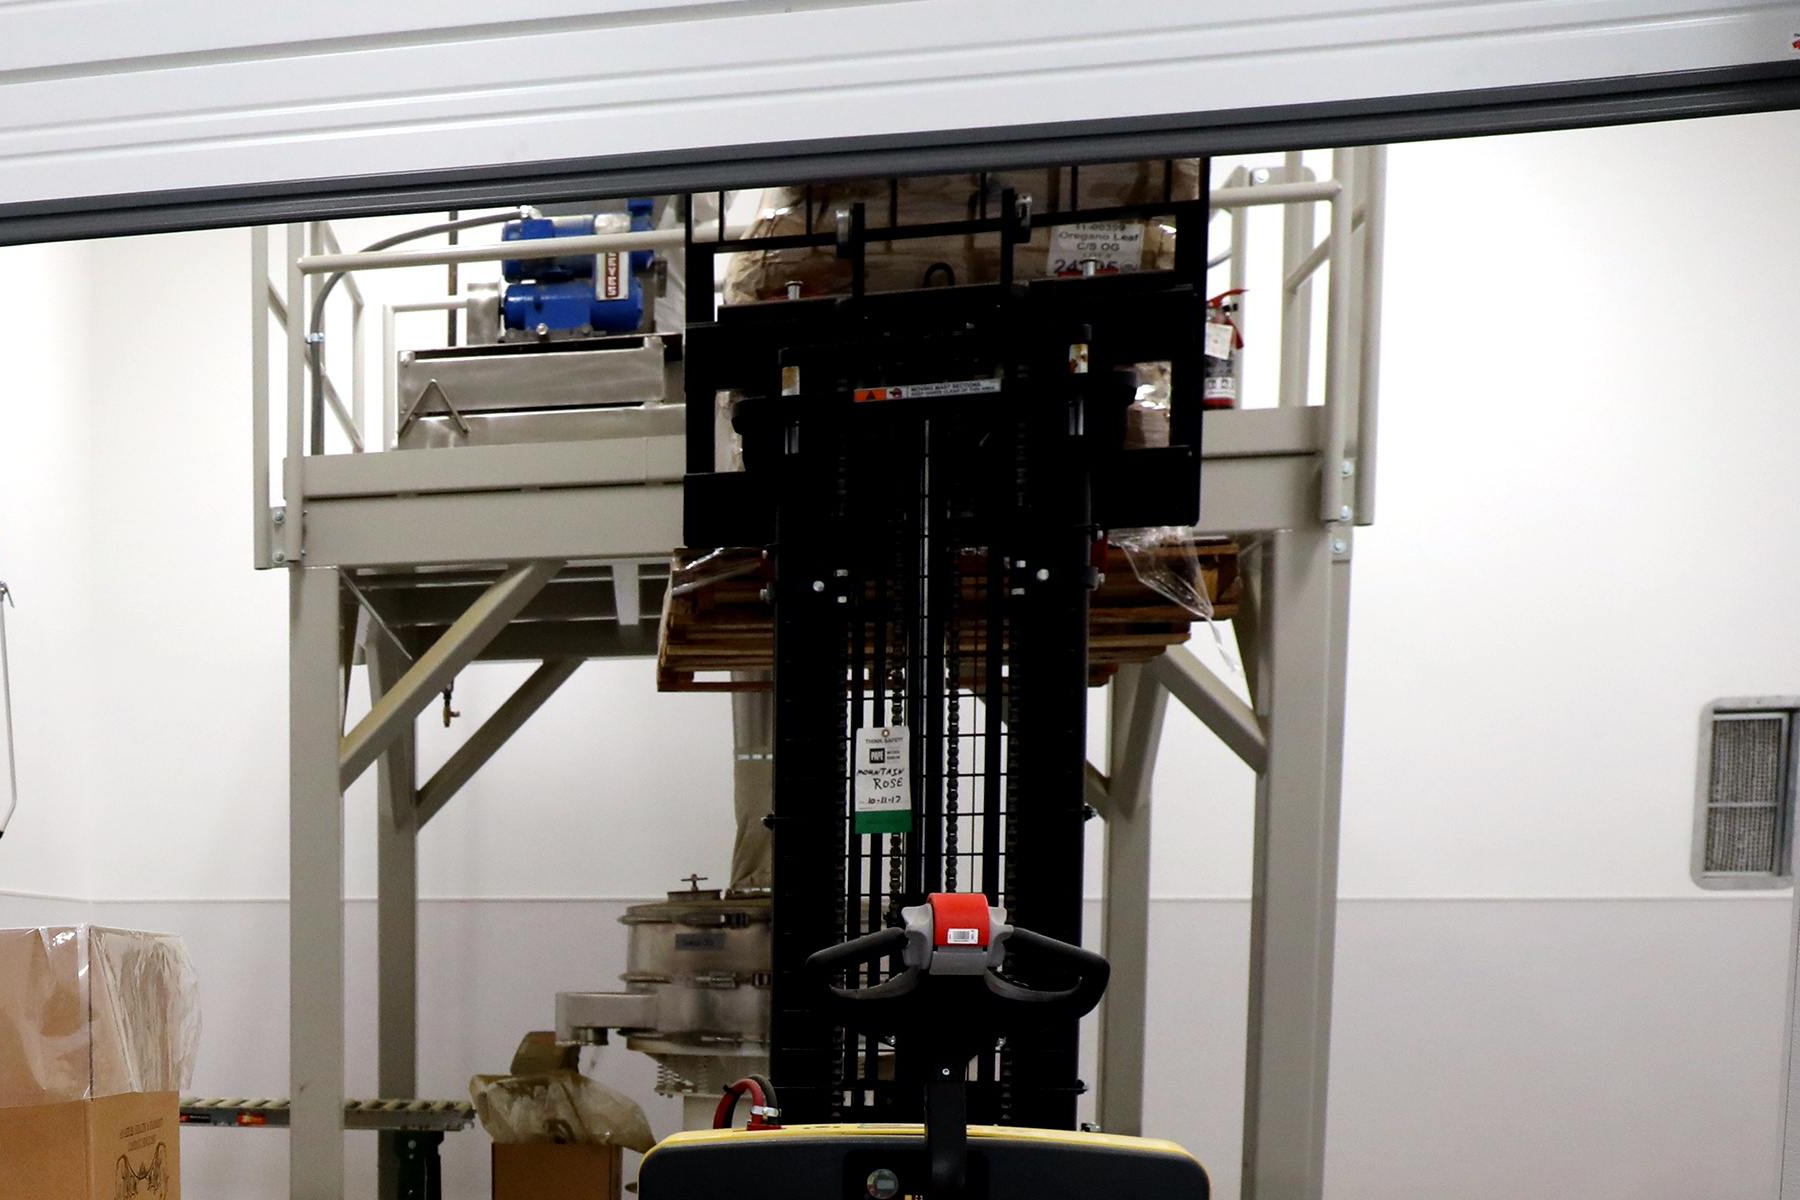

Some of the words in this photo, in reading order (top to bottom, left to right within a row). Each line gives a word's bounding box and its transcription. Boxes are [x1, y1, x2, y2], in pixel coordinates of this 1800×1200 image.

[1060, 231, 1110, 241] Oregano
[1114, 233, 1139, 242] Leaf
[857, 767, 905, 776] MOUNTAIN
[873, 777, 903, 790] ROSE
